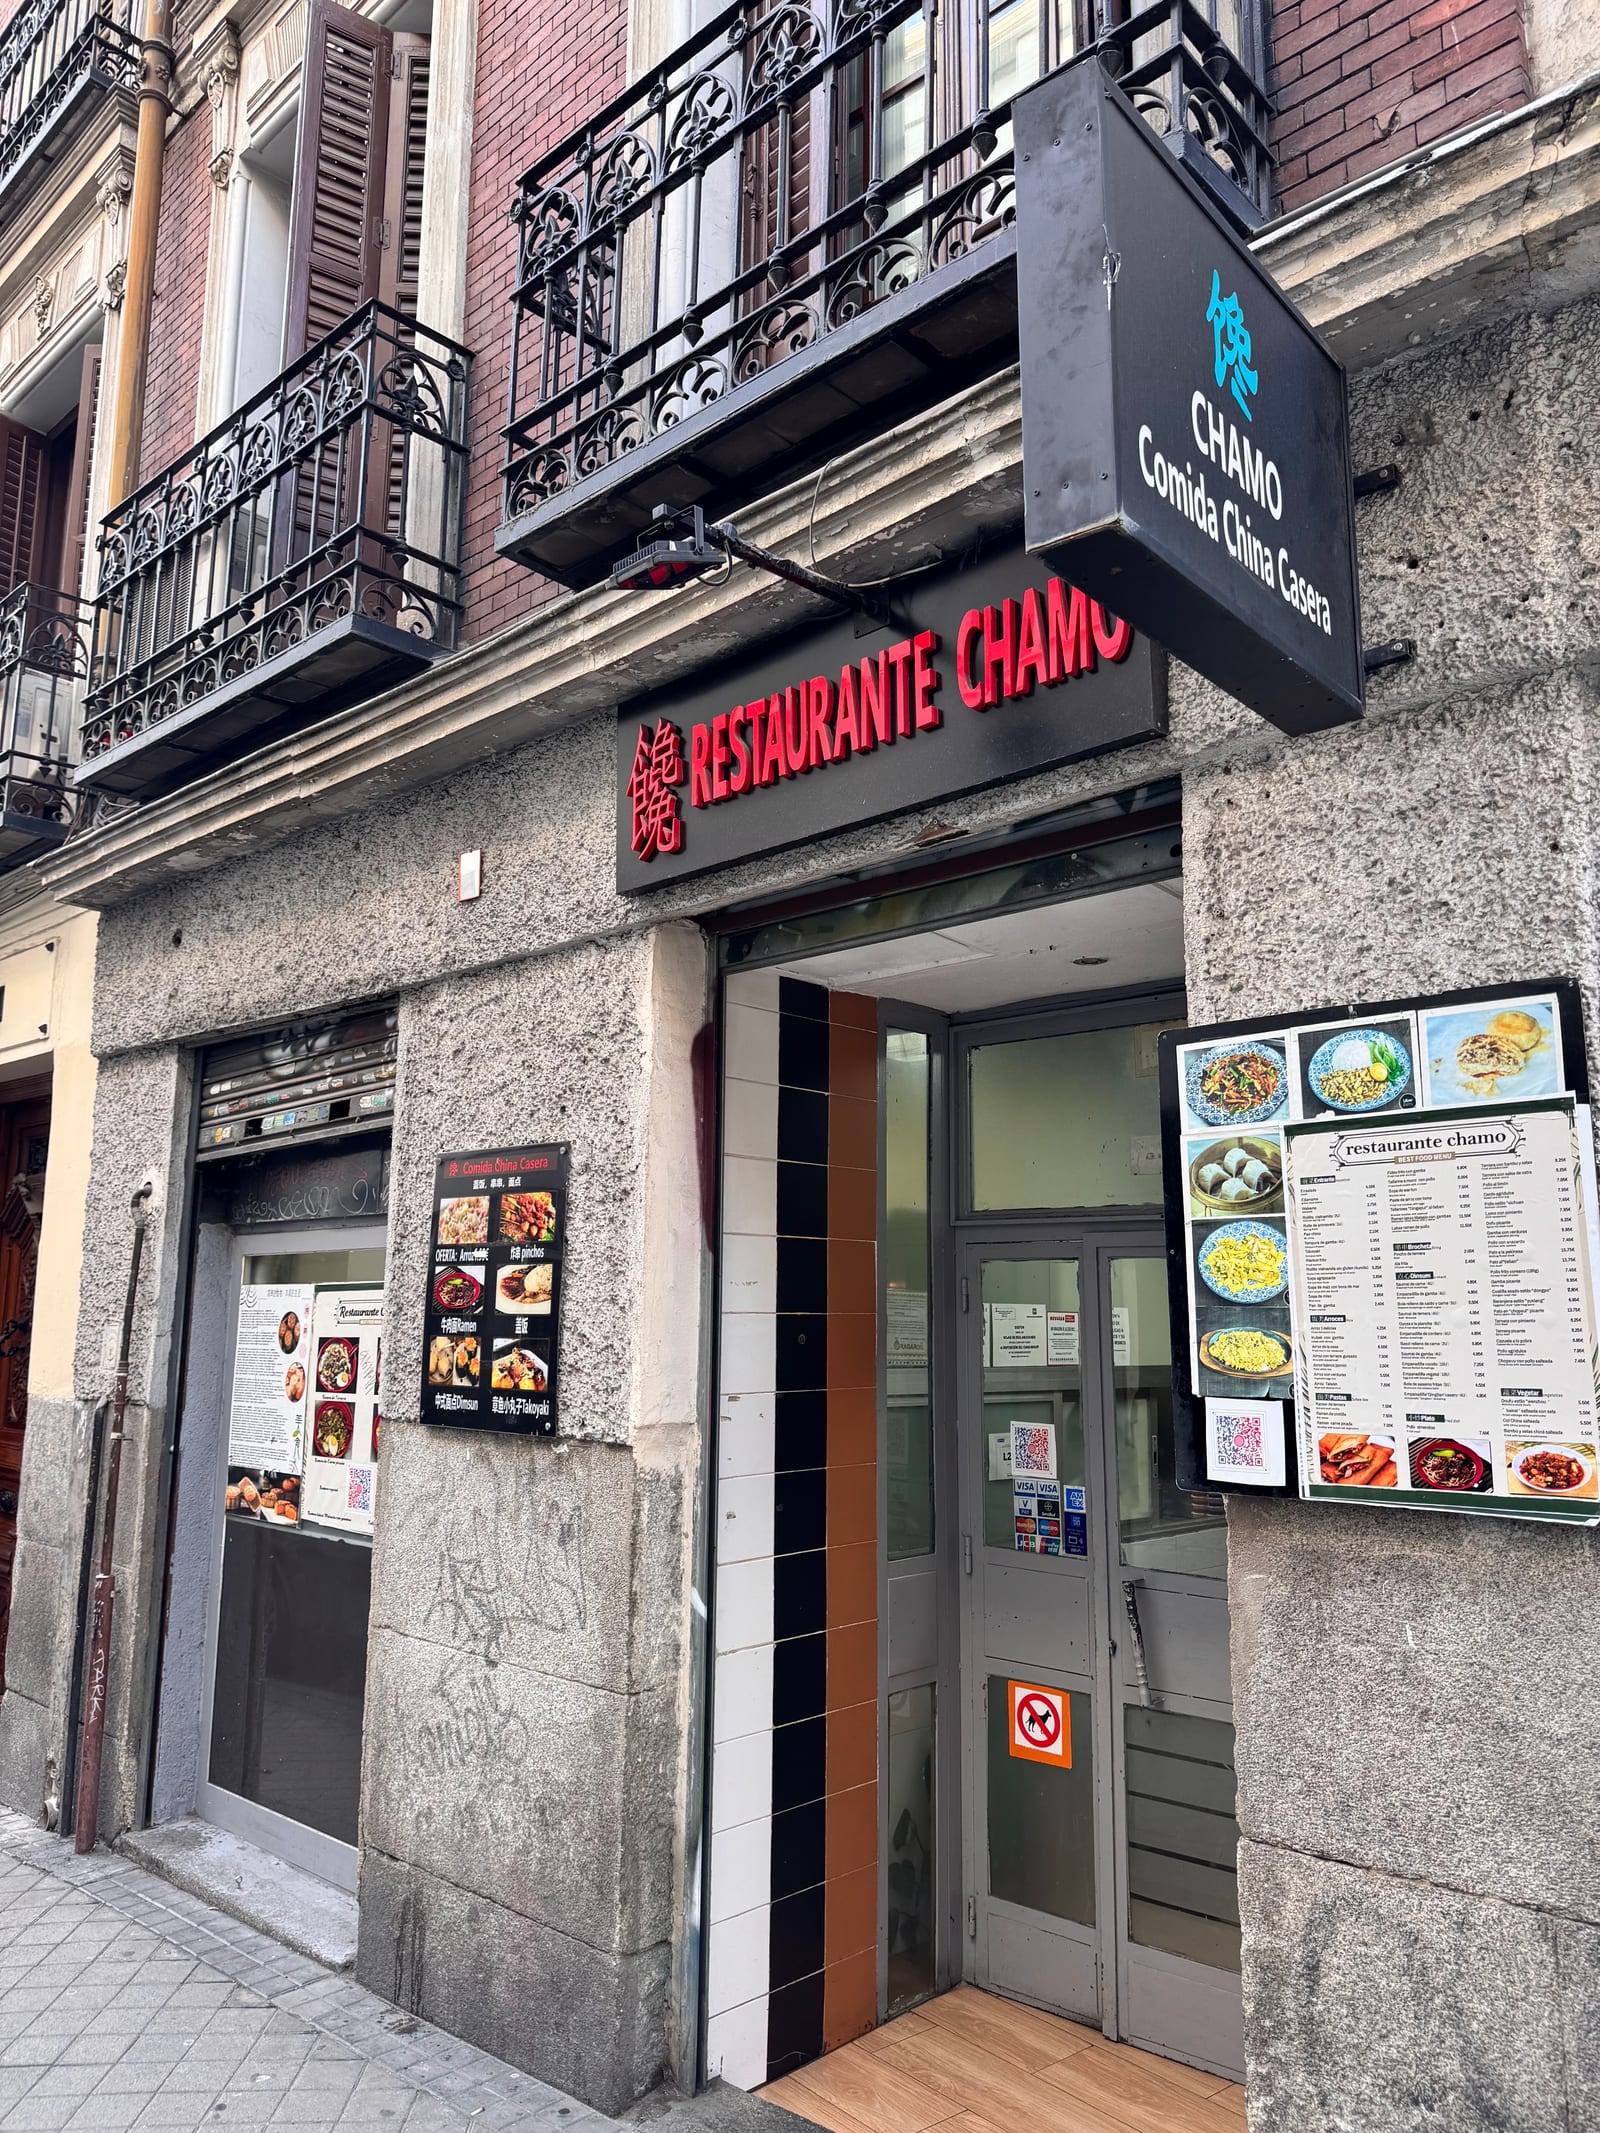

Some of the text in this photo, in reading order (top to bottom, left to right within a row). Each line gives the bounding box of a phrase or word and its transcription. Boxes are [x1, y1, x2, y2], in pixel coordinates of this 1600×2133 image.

[1192, 391, 1282, 520] CHAMO
[1138, 424, 1331, 636] Comida China Casera
[691, 577, 1130, 807] RESTAURANTE CHAMO
[1346, 1131, 1507, 1156] restaurante chamo
[1433, 1153, 1453, 1161] MENU
[462, 1160, 493, 1175] Comida
[494, 1157, 518, 1173] China
[519, 1155, 549, 1171] Casera
[435, 1249, 458, 1262] OFERTA:
[521, 1246, 545, 1261] pinchos
[1016, 1481, 1035, 1491] VISA
[1039, 1483, 1058, 1494] VISA
[1018, 1540, 1035, 1548] JCB
